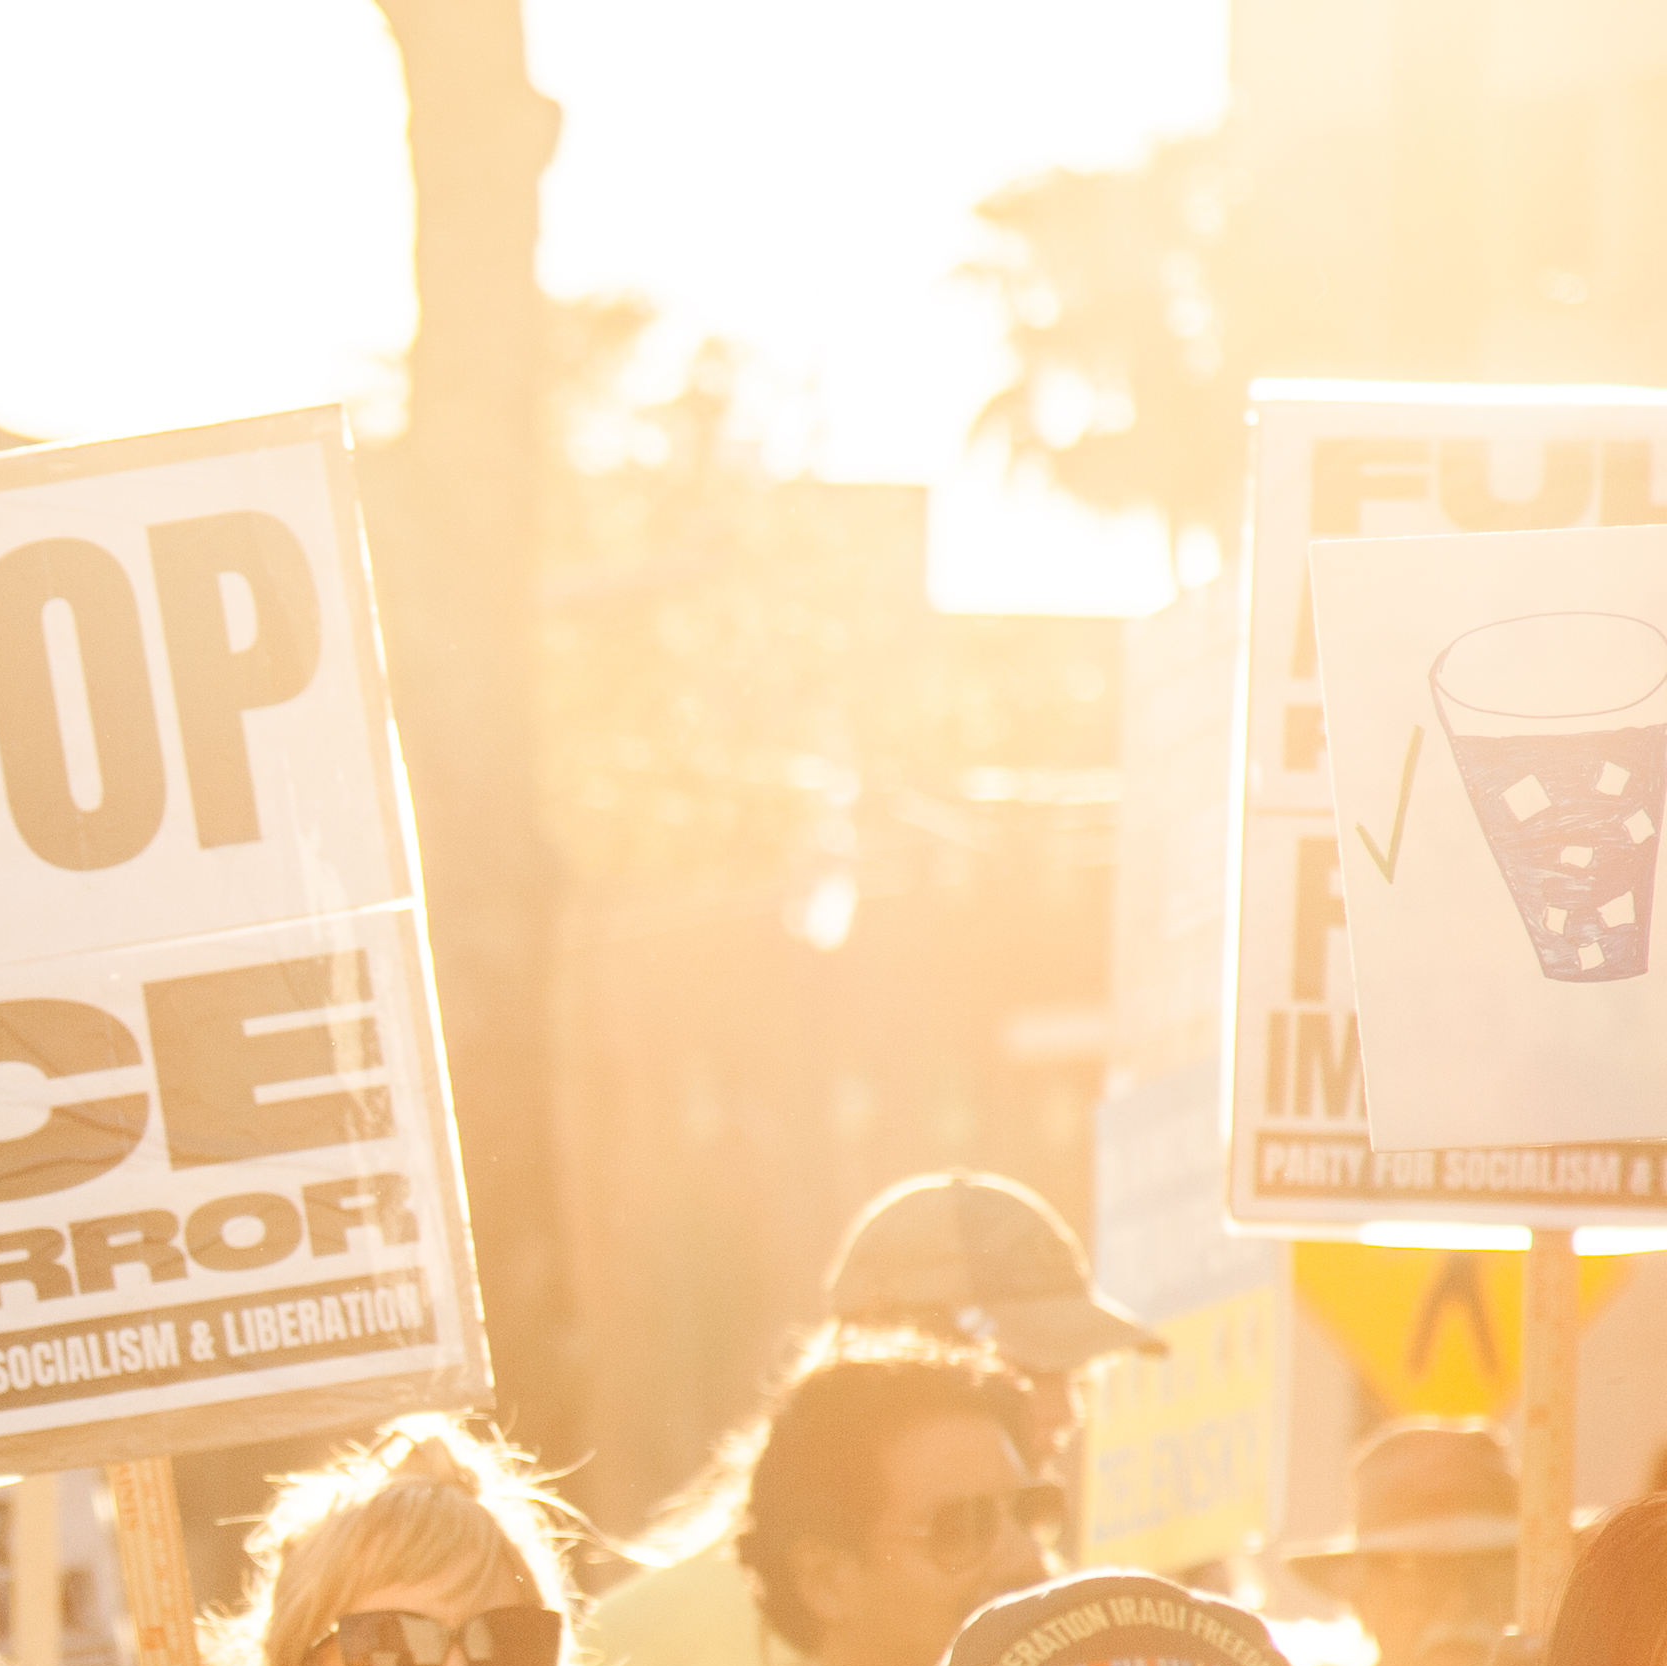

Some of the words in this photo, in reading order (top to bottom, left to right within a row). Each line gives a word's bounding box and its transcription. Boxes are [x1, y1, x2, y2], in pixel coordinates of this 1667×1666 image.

[1264, 1138, 1364, 1189] PARTY
[1373, 1141, 1436, 1192] FOR
[1444, 1141, 1620, 1193] SOCIALISM
[190, 1322, 215, 1362] &
[226, 1281, 427, 1358] LIBERATION
[1108, 1596, 1187, 1631] IRAQI
